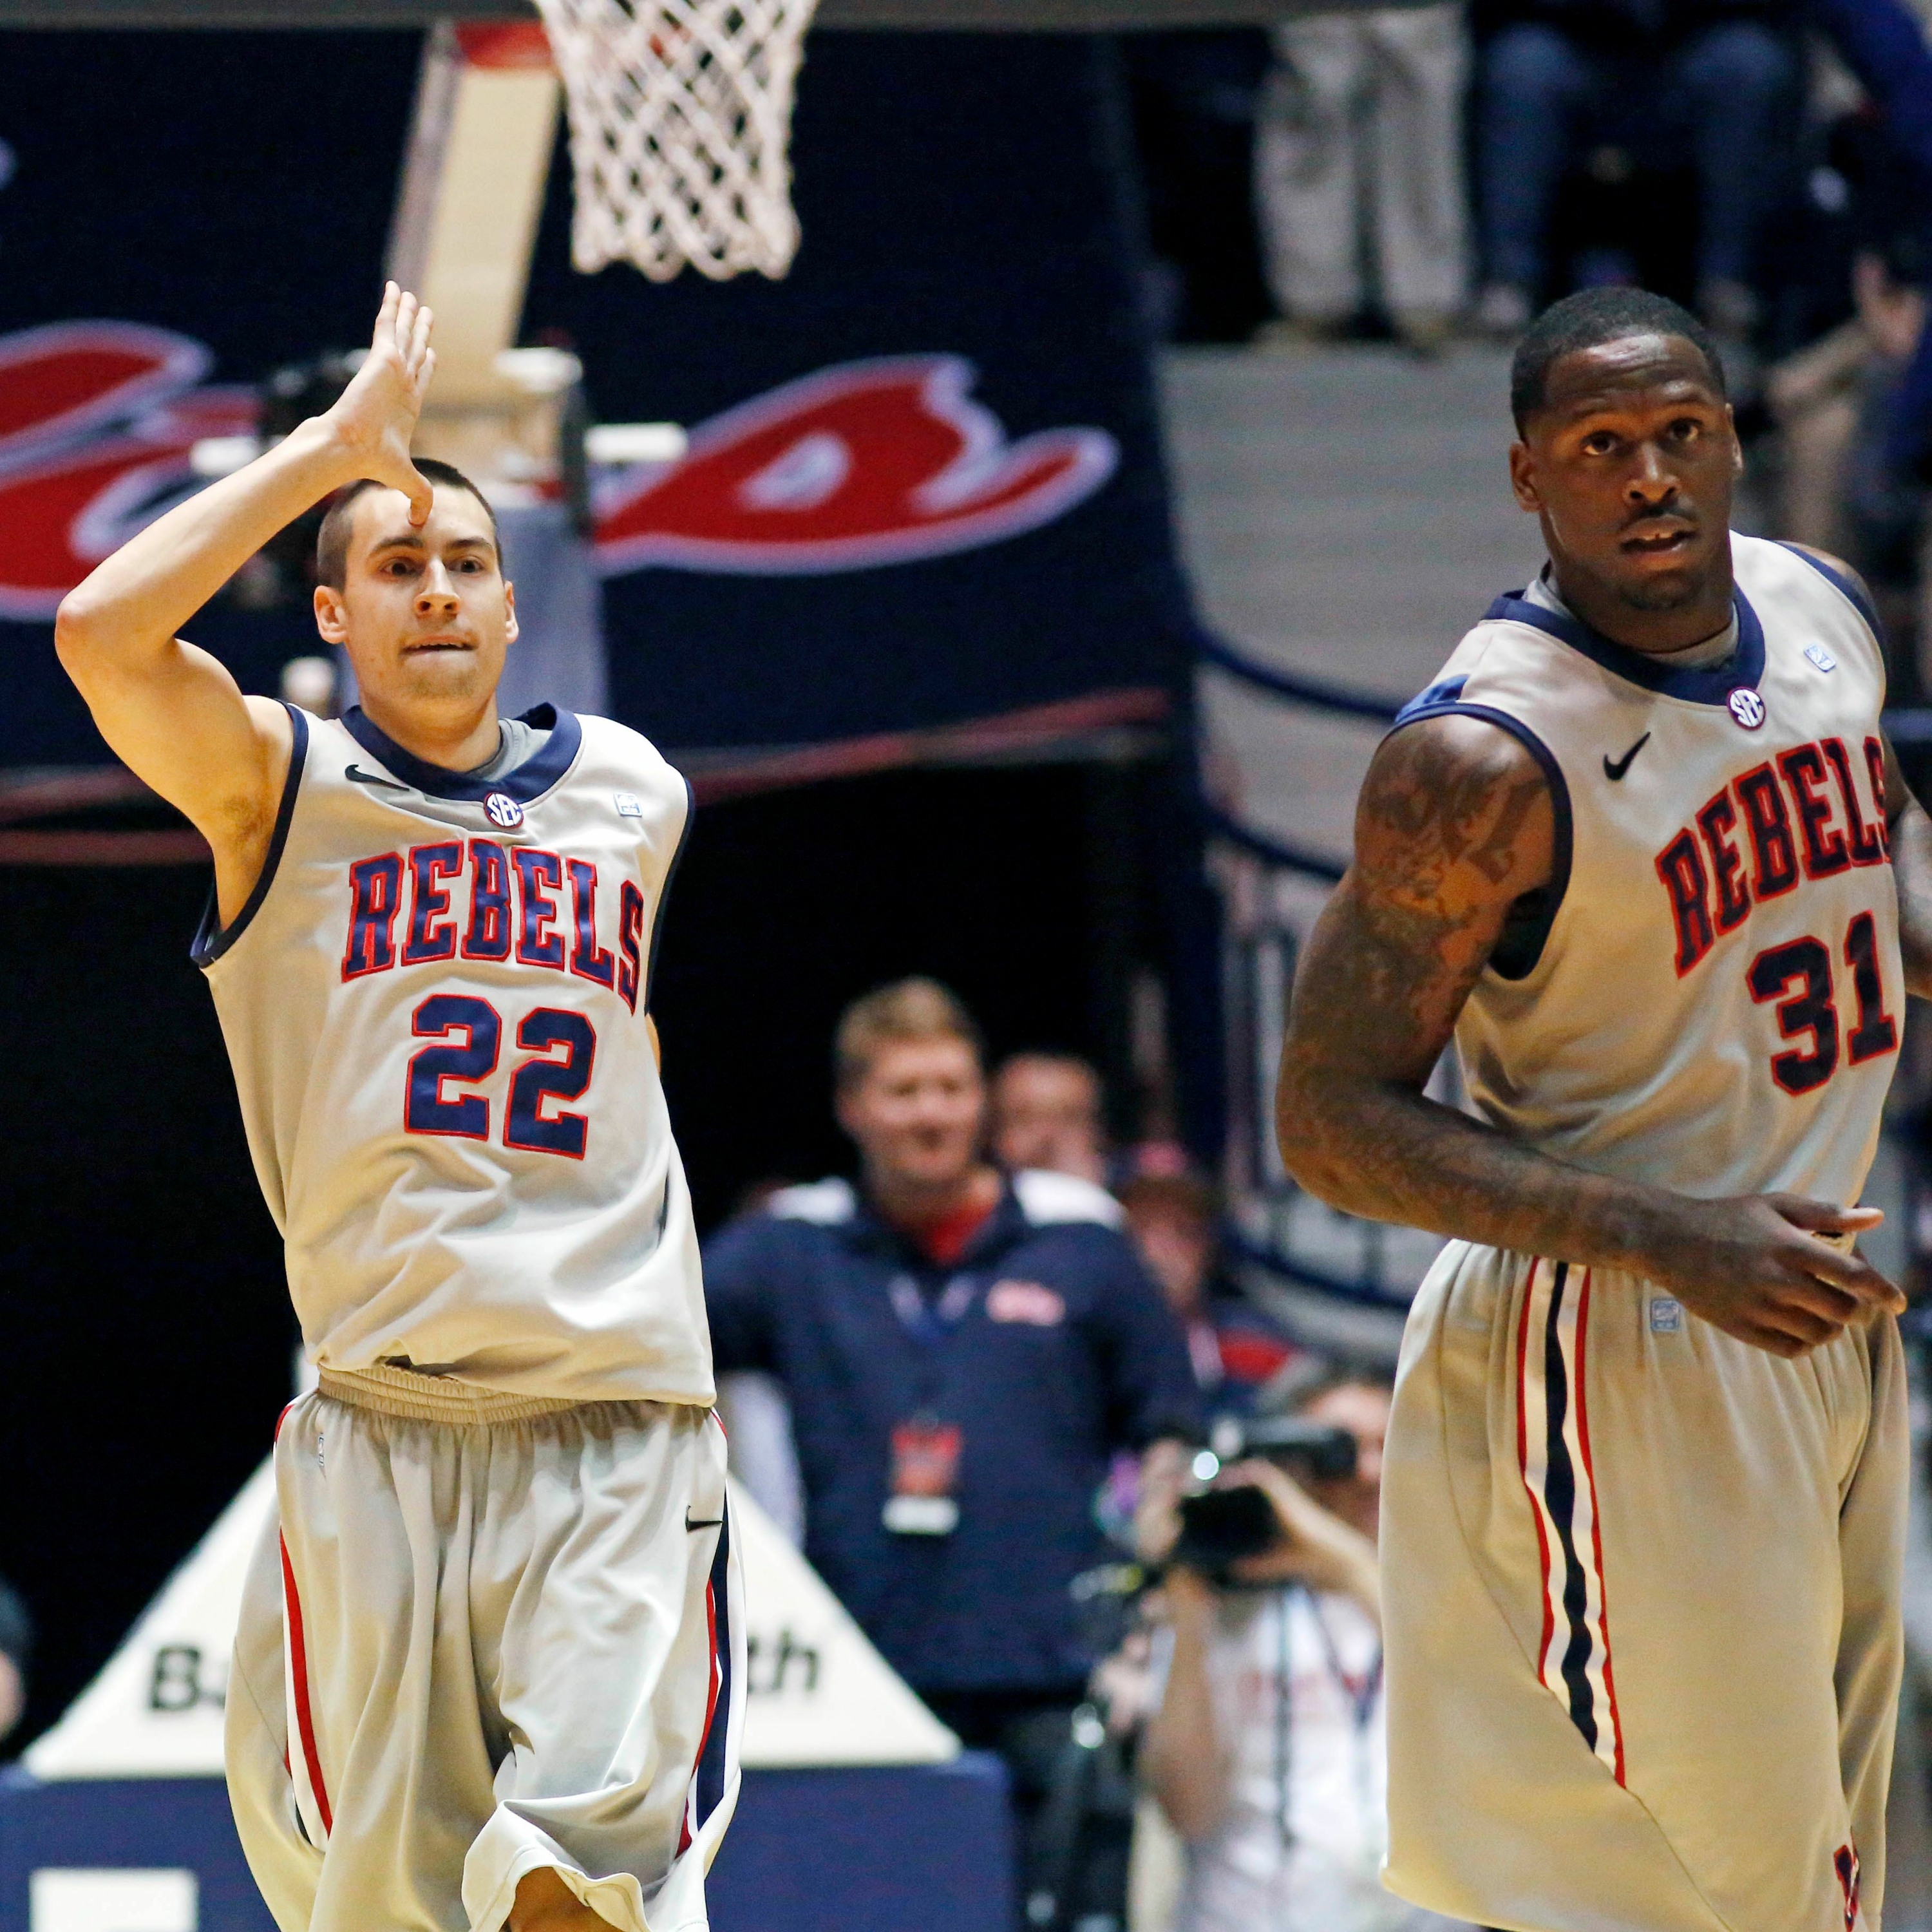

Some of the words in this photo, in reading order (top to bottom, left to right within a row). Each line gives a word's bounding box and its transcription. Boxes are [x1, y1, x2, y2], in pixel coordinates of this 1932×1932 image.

[1729, 688, 1765, 727] SEC
[486, 793, 522, 827] SEC
[341, 838, 643, 1017] REBELS
[1745, 909, 1898, 1097] 31
[404, 993, 596, 1160] 22
